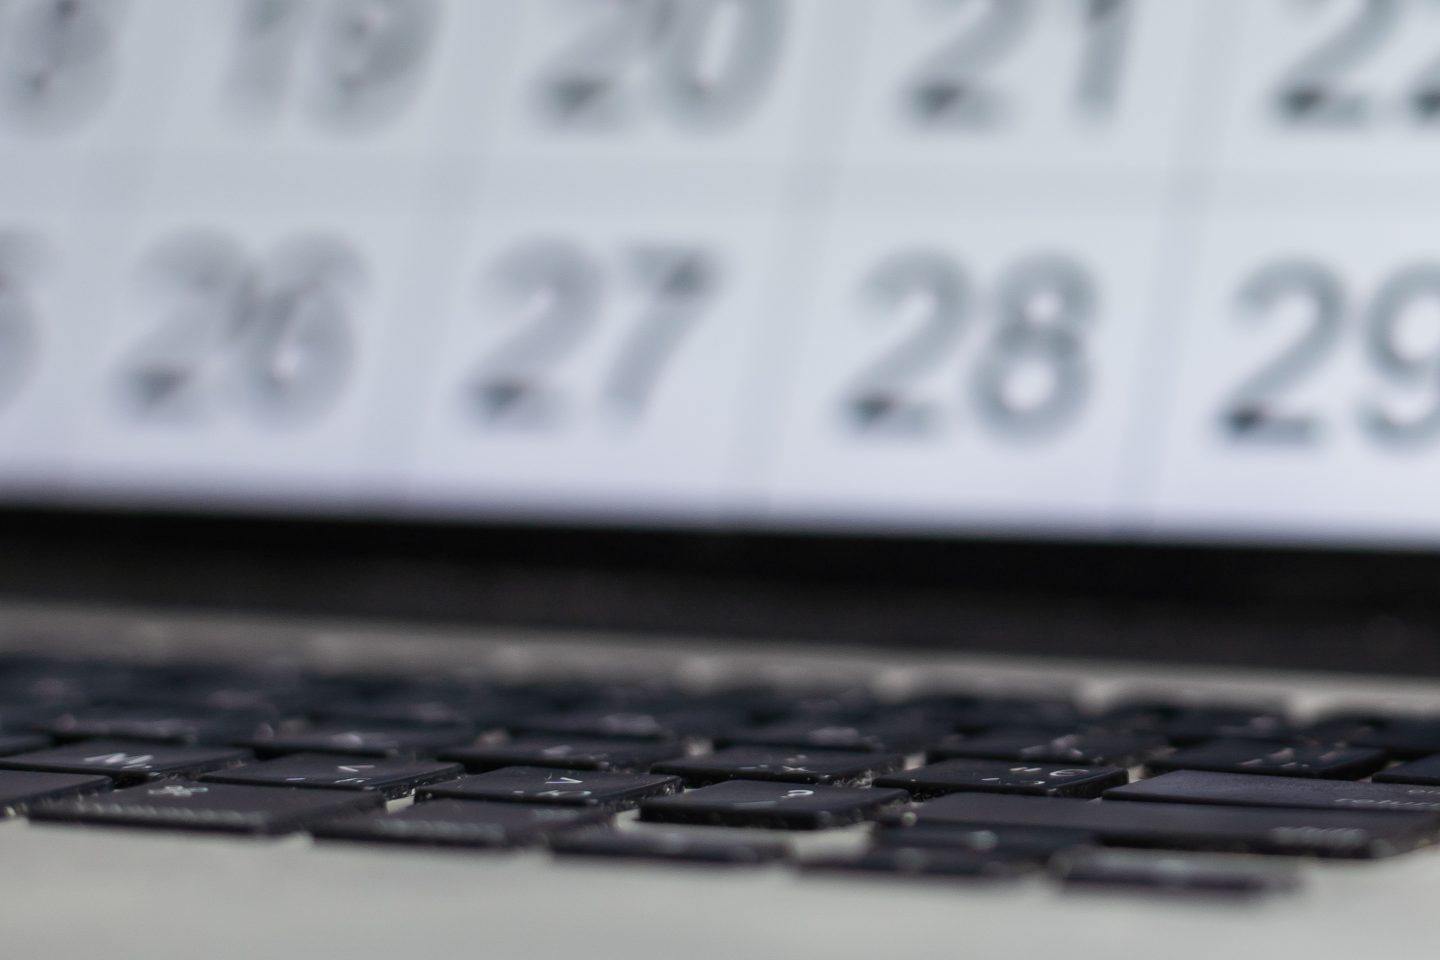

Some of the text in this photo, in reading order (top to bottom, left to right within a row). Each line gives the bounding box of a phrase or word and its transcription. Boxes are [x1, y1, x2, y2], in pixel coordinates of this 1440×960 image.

[112, 226, 370, 432] 26
[468, 232, 722, 434] 27
[837, 246, 1098, 448] 28
